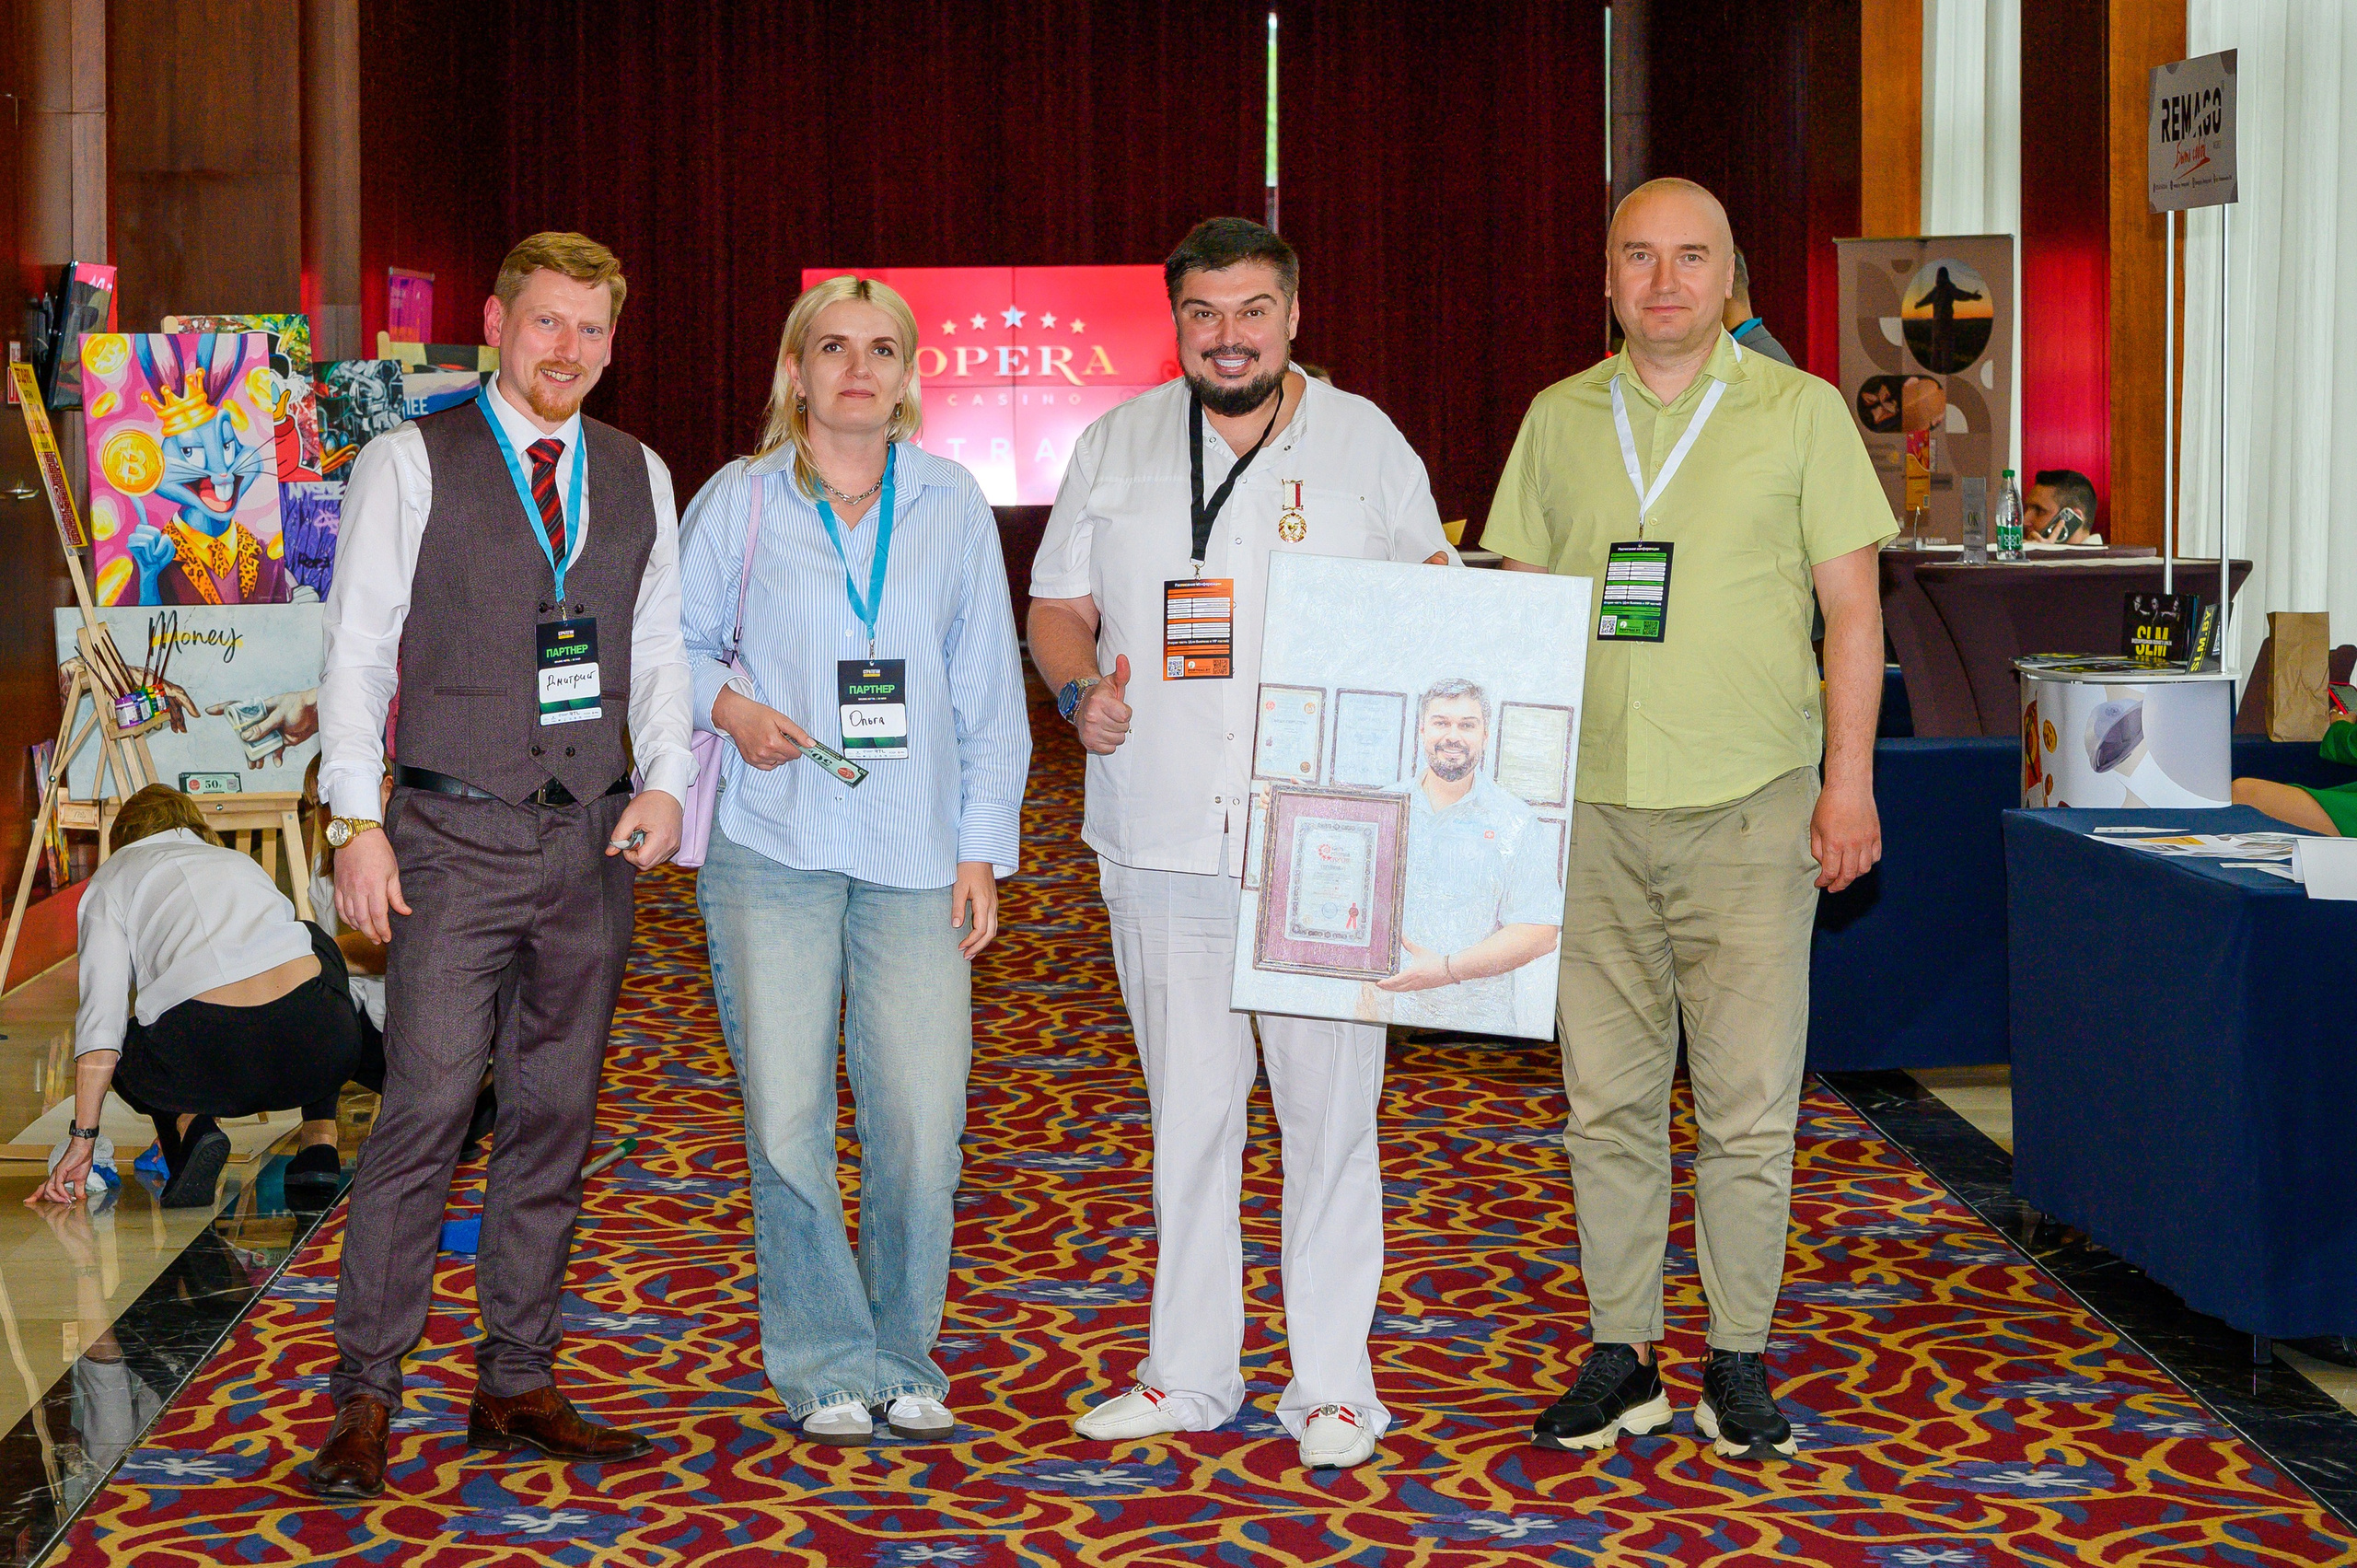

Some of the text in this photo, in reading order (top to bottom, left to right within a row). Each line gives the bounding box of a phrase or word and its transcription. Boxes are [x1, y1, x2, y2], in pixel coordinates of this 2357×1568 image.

[2162, 87, 2222, 143] REMAGO
[916, 345, 1119, 386] OPERA
[947, 394, 1082, 405] CASINO
[916, 438, 1057, 462] TRA
[149, 610, 243, 663] Money
[2135, 625, 2169, 657] SLM
[2190, 610, 2212, 672] SLM.BY
[546, 644, 588, 658] ПАРТНЕР
[849, 684, 896, 694] ПАРТНЕР
[850, 710, 885, 726] Ольга
